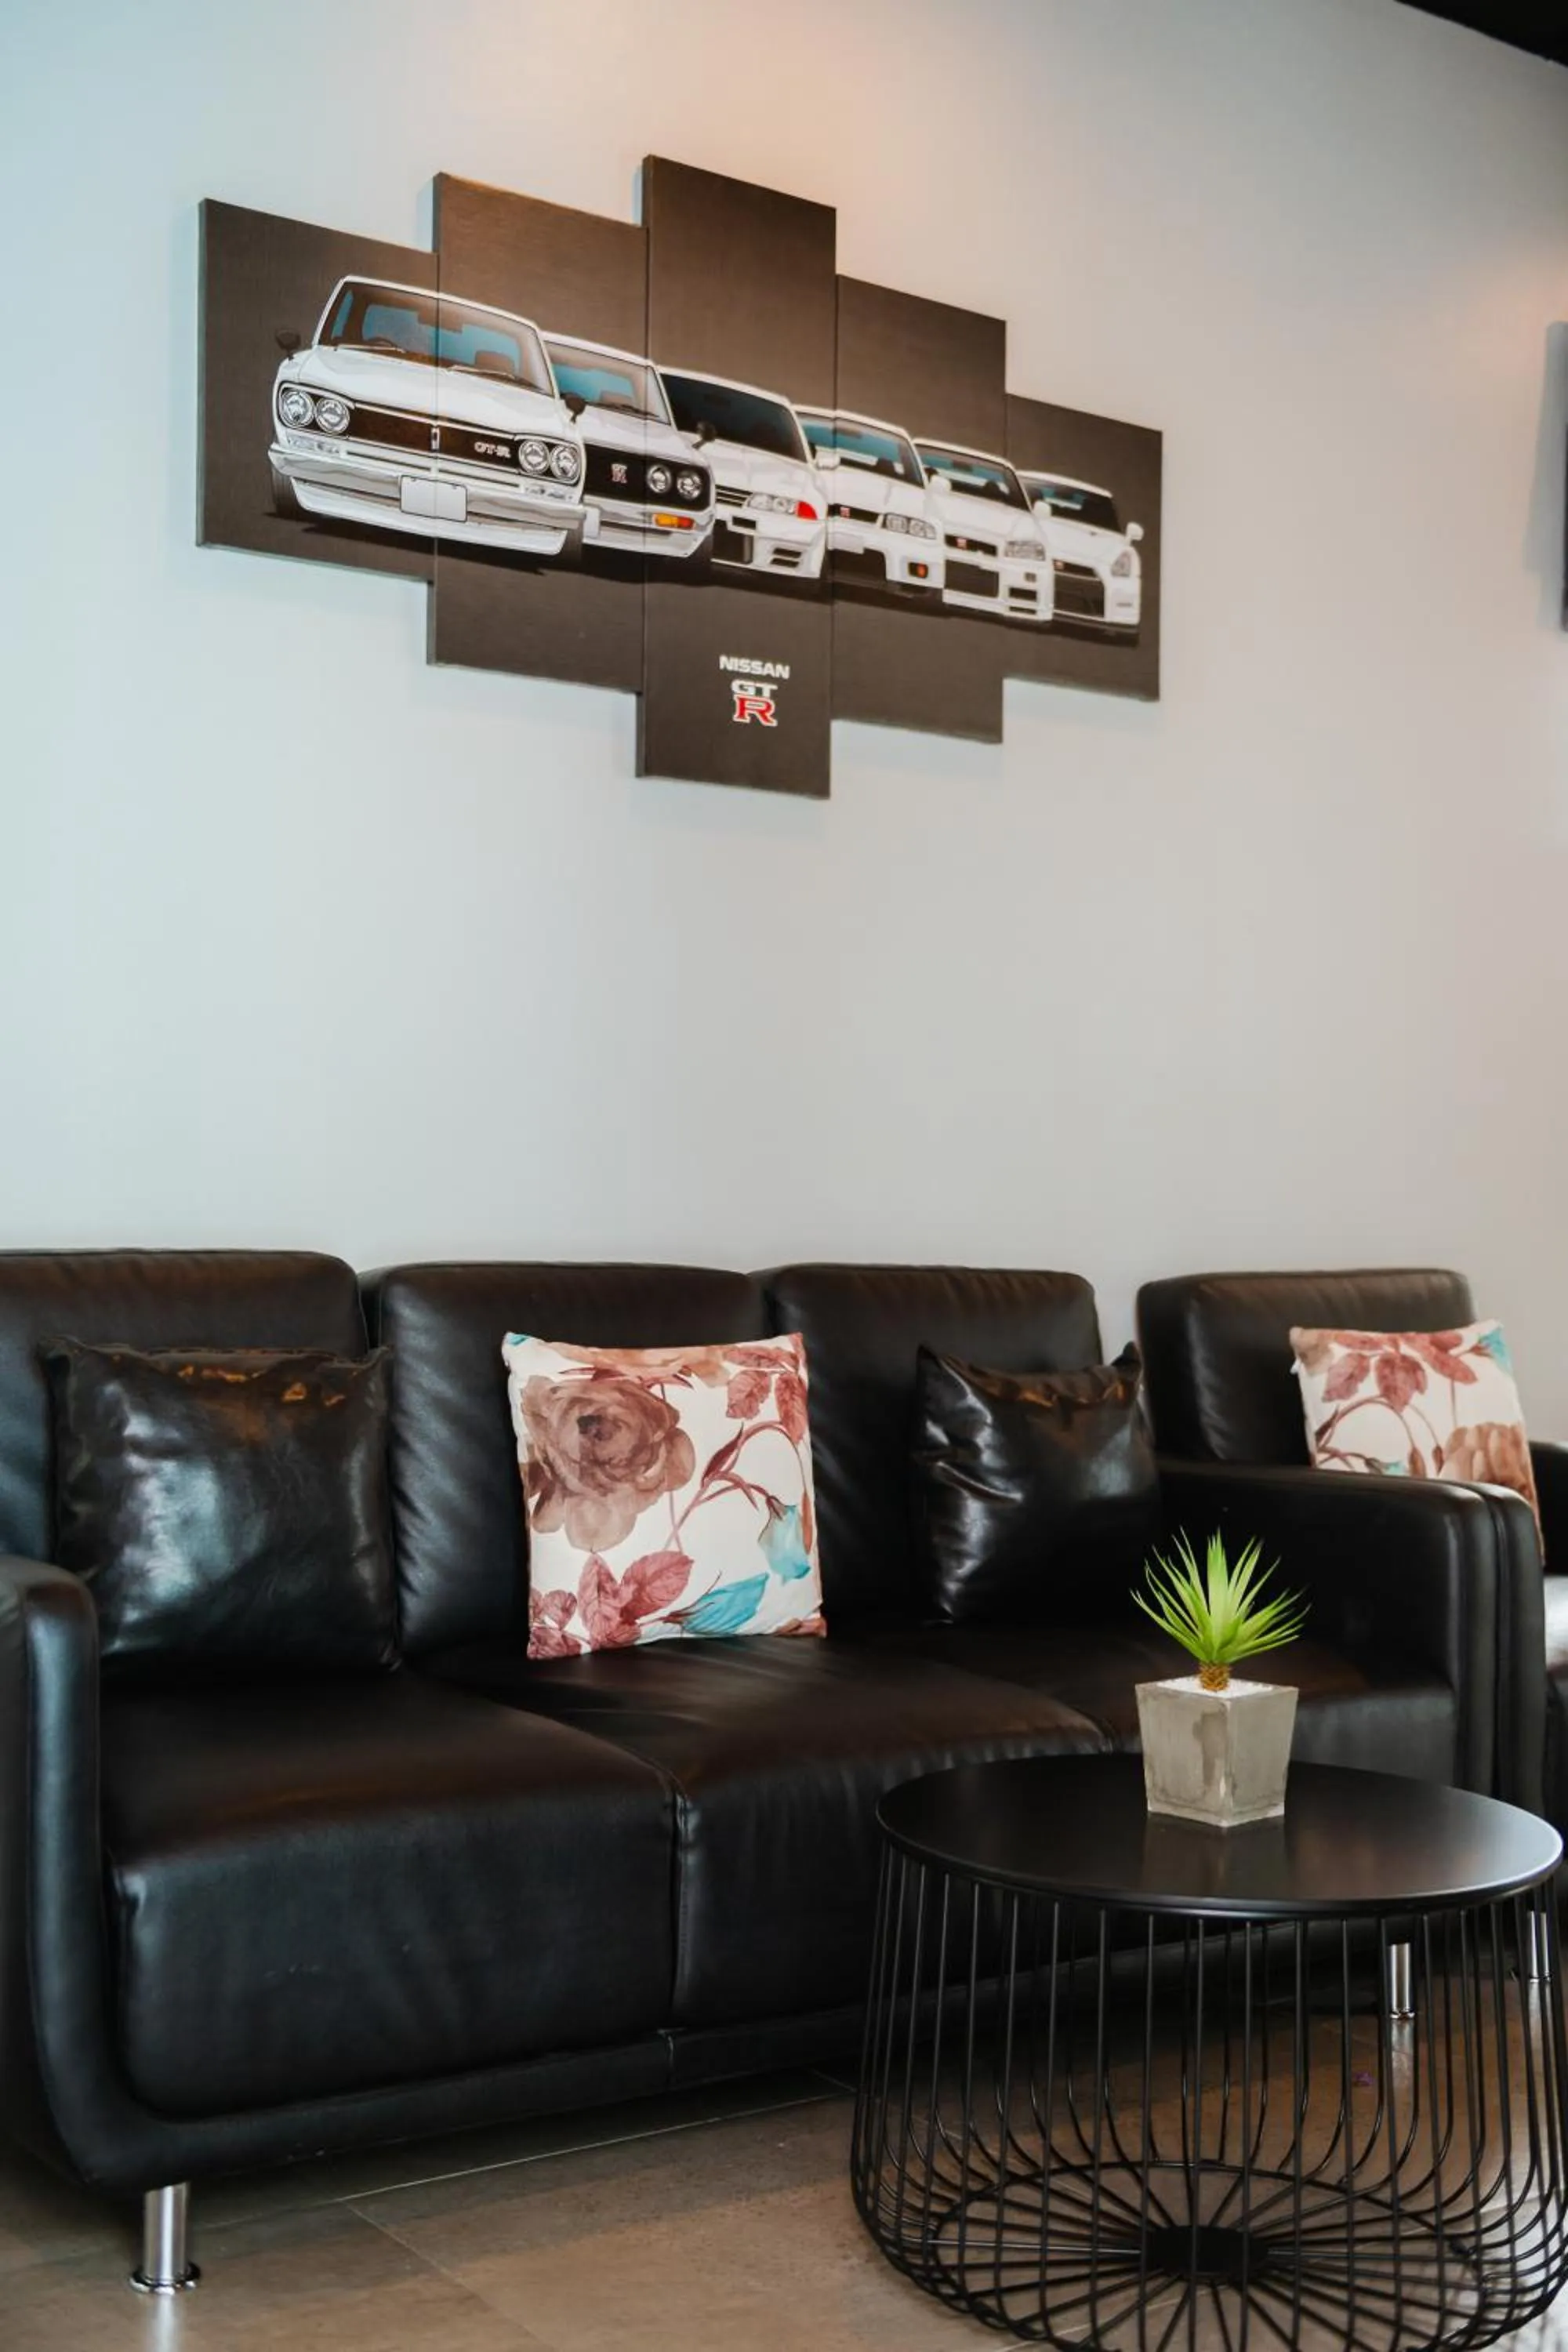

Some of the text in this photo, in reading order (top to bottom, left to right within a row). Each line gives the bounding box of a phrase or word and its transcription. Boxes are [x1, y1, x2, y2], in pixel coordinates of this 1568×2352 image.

[719, 655, 790, 680] NISSAN
[731, 679, 778, 697] GT
[733, 694, 778, 727] R
